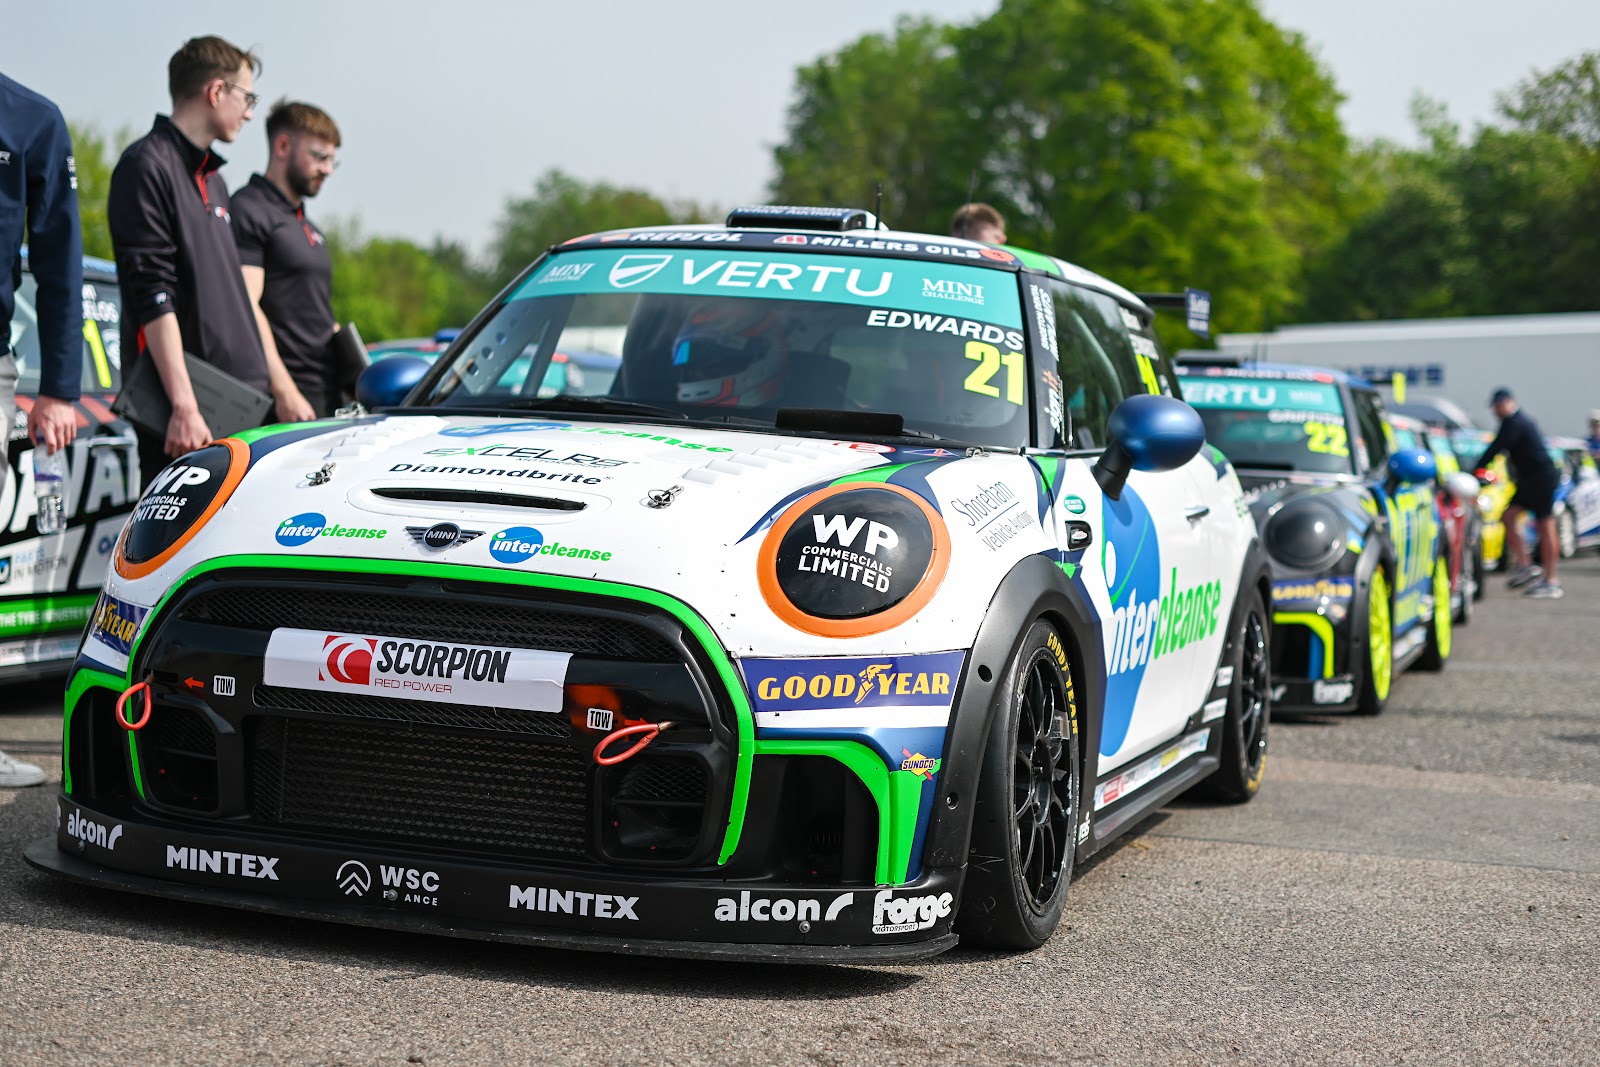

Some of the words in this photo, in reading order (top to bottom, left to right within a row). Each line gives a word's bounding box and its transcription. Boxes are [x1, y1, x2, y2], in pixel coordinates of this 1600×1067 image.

[630, 232, 743, 243] REPSOL
[811, 236, 919, 252] MILLERS
[924, 245, 982, 260] OILS
[546, 262, 597, 277] MINI
[682, 259, 894, 298] VERTU
[921, 290, 985, 306] CHALLENGE
[922, 278, 985, 299] MINI
[867, 309, 1024, 351] EDWARDS
[963, 340, 1024, 406] 21
[1303, 420, 1349, 458] 22
[389, 463, 602, 485] Diamondbrite
[950, 481, 1014, 527] Shoreham
[278, 519, 387, 539] intercleanse
[426, 530, 456, 541] MINI
[812, 514, 899, 556] WP
[981, 522, 1018, 552] Vehicle
[491, 530, 612, 562] intercleanse
[797, 555, 890, 594] LIMITED
[802, 545, 893, 577] COMMERCIALS
[376, 641, 512, 684] SCORPION
[215, 677, 234, 695] TOW
[374, 678, 401, 689] RED
[403, 681, 453, 693] POWER
[590, 710, 612, 729] TOW
[902, 758, 935, 771] SUNOCO
[67, 808, 108, 849] alcon
[166, 845, 280, 881] MINTEX
[379, 864, 440, 892] WSC
[383, 890, 438, 907] FANCE
[508, 884, 640, 922] MINTEX
[713, 890, 821, 923] alcon
[875, 924, 916, 933] MOTORSPORT
